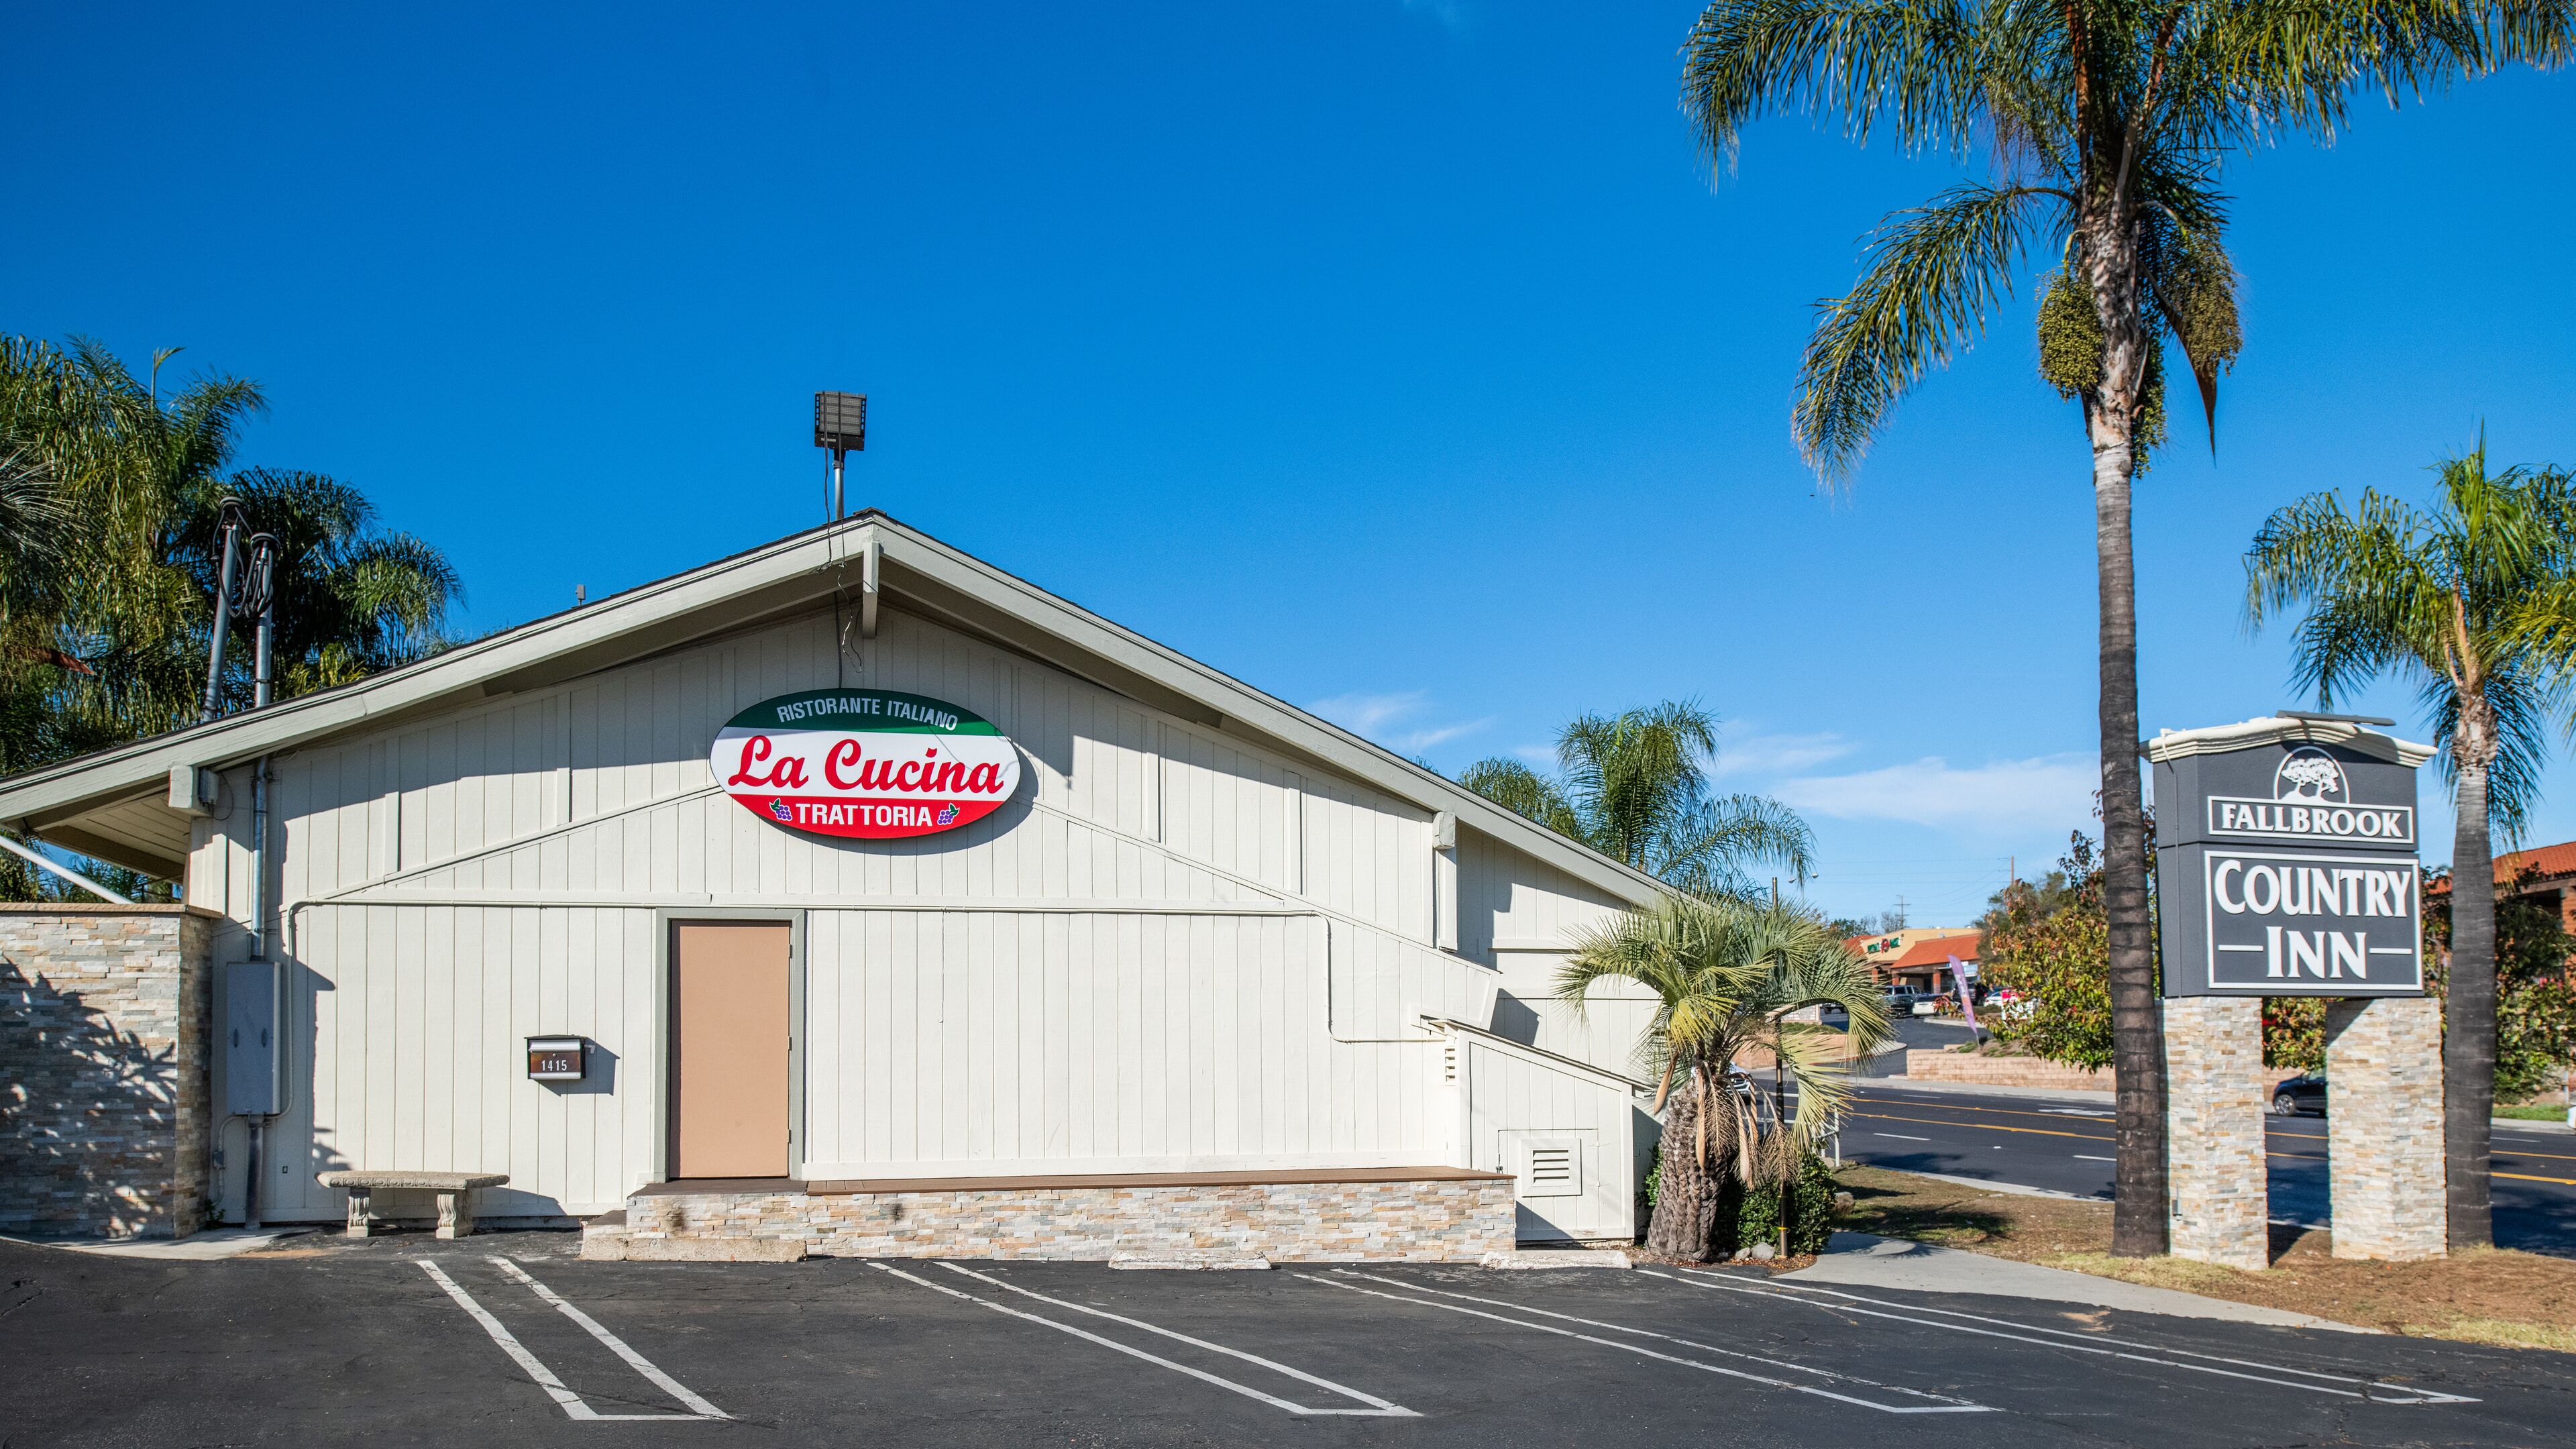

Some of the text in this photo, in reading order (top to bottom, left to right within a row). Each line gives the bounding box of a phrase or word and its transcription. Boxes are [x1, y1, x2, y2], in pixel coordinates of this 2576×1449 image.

[777, 698, 959, 731] RISTORANTE ITALIANO
[728, 735, 1004, 794] La Cucina
[796, 803, 932, 826] TRATTORIA
[2221, 803, 2404, 837] FALLBROOK
[2214, 859, 2412, 917] COUNTRY
[2265, 926, 2367, 979] INN
[541, 1060, 568, 1071] 1415
